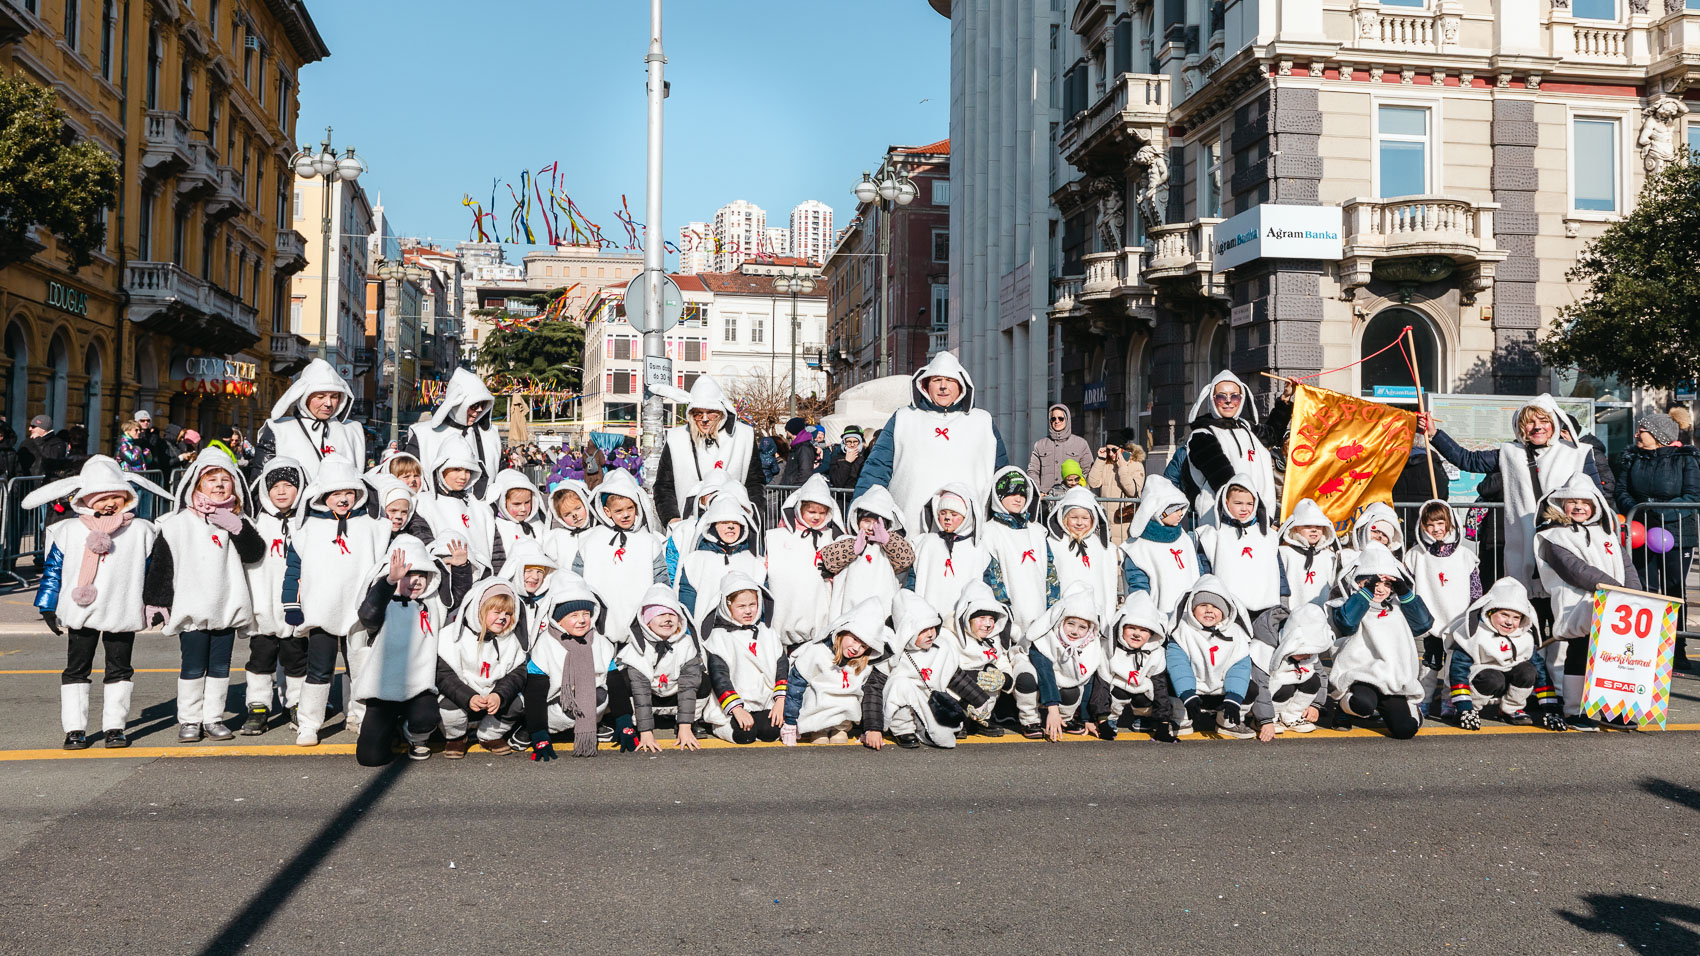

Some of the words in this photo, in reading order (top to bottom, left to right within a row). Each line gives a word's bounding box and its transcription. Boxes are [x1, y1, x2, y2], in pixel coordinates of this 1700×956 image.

[1266, 226, 1338, 240] AgramBanka
[49, 281, 88, 316] DOUGLAS
[182, 377, 253, 397] CASINO
[1384, 388, 1417, 396] AgramBan
[1610, 604, 1653, 639] 30
[1603, 680, 1635, 691] SPAR
